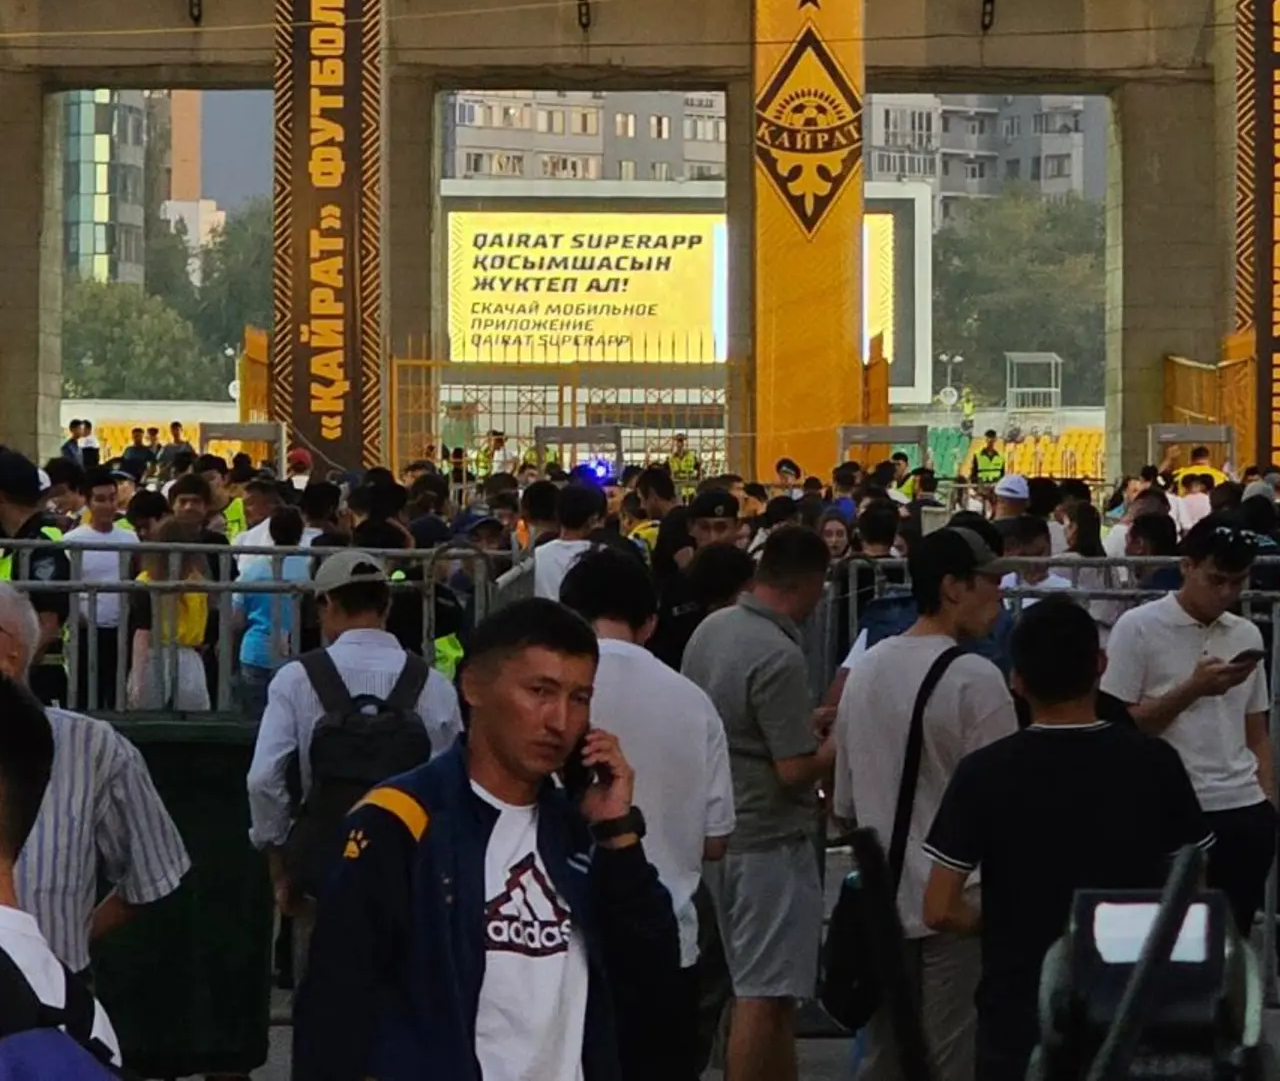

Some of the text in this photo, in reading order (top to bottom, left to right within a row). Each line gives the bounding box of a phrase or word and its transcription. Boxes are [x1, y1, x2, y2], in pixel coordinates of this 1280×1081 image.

[472, 233, 703, 250] QAIRAT SUPERAPP
[472, 255, 672, 272] ҚОСЫМШАСЫН
[472, 276, 629, 293] ЖҮКТЕП АЛ!
[471, 301, 659, 317] СКАЧАЙ МОБИЛЬНОЕ
[299, 203, 350, 439] «ҚАЙРАТ»
[470, 318, 595, 332] ПРИЛОЖЕНИЕ
[486, 919, 572, 949] addas
